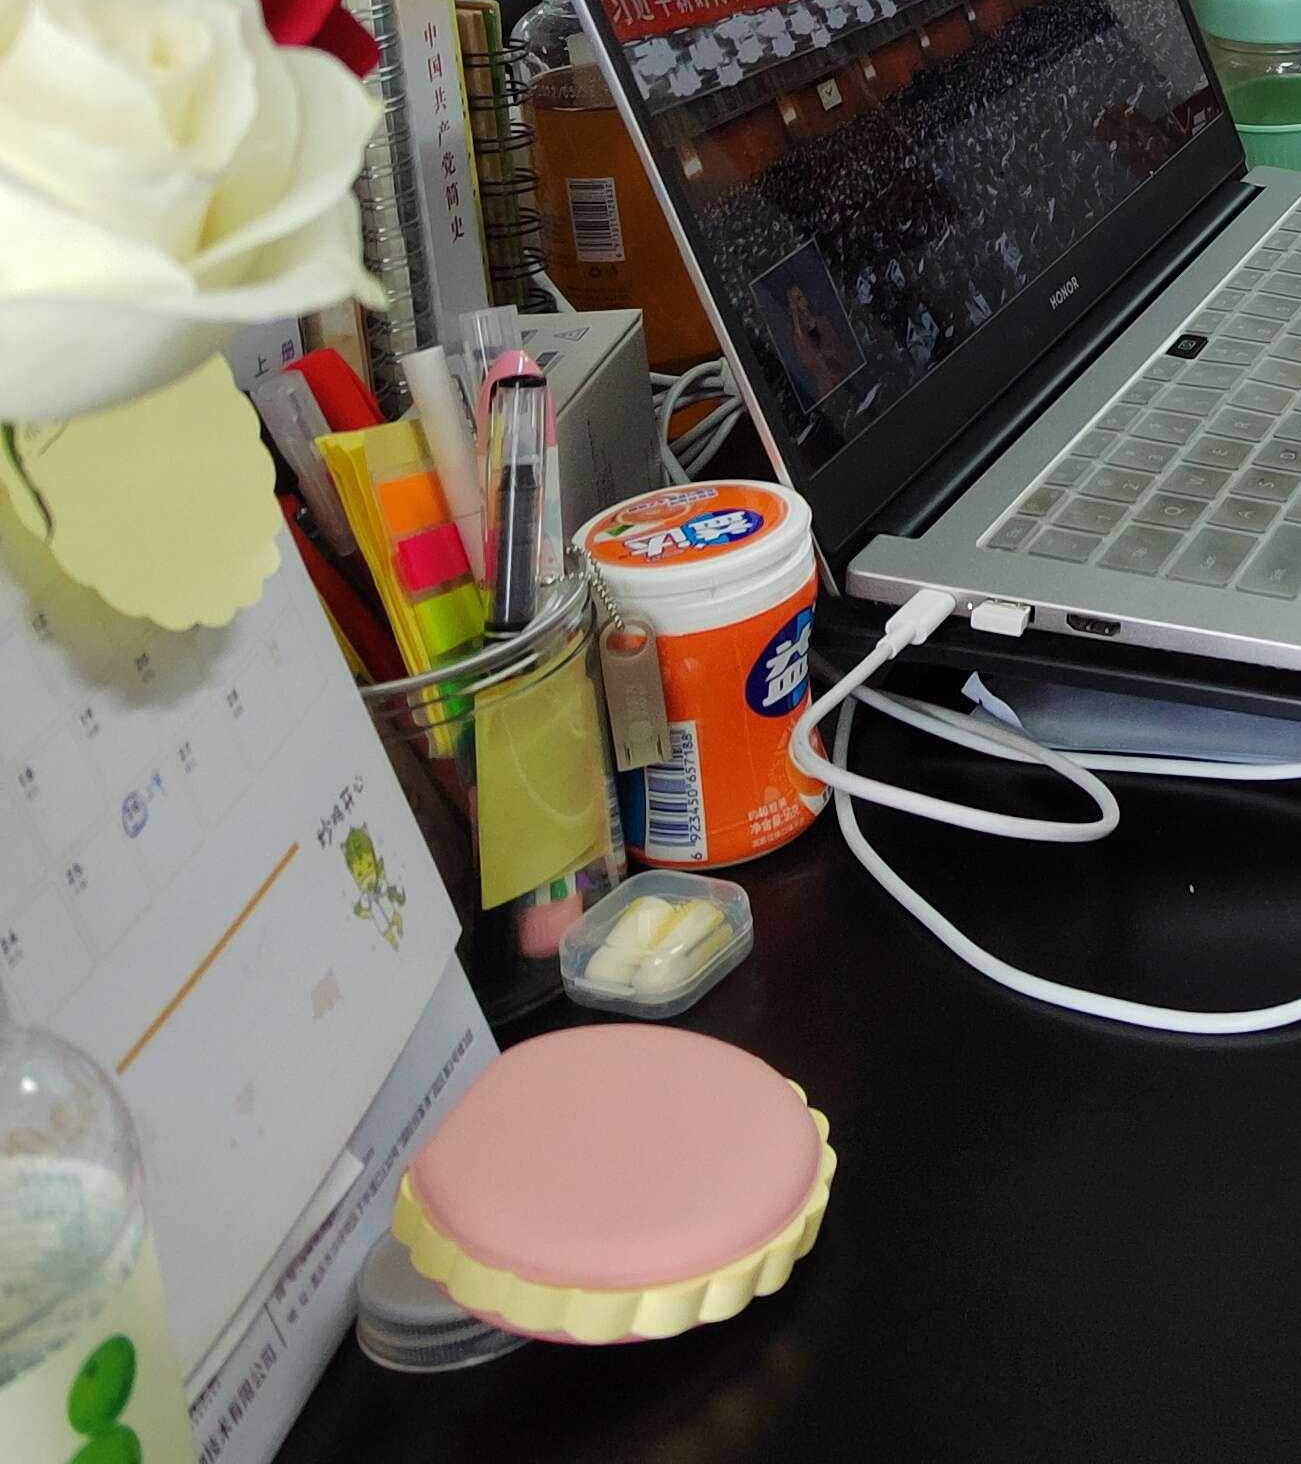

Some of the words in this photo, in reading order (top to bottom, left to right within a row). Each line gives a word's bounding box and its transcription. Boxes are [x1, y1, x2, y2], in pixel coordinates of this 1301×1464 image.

[422, 20, 465, 244] 中国共产党简史
[1049, 275, 1080, 311] HONOR
[622, 510, 754, 559] 益达
[683, 732, 698, 786] 657188
[687, 788, 702, 842] 923450
[692, 851, 703, 862] 6
